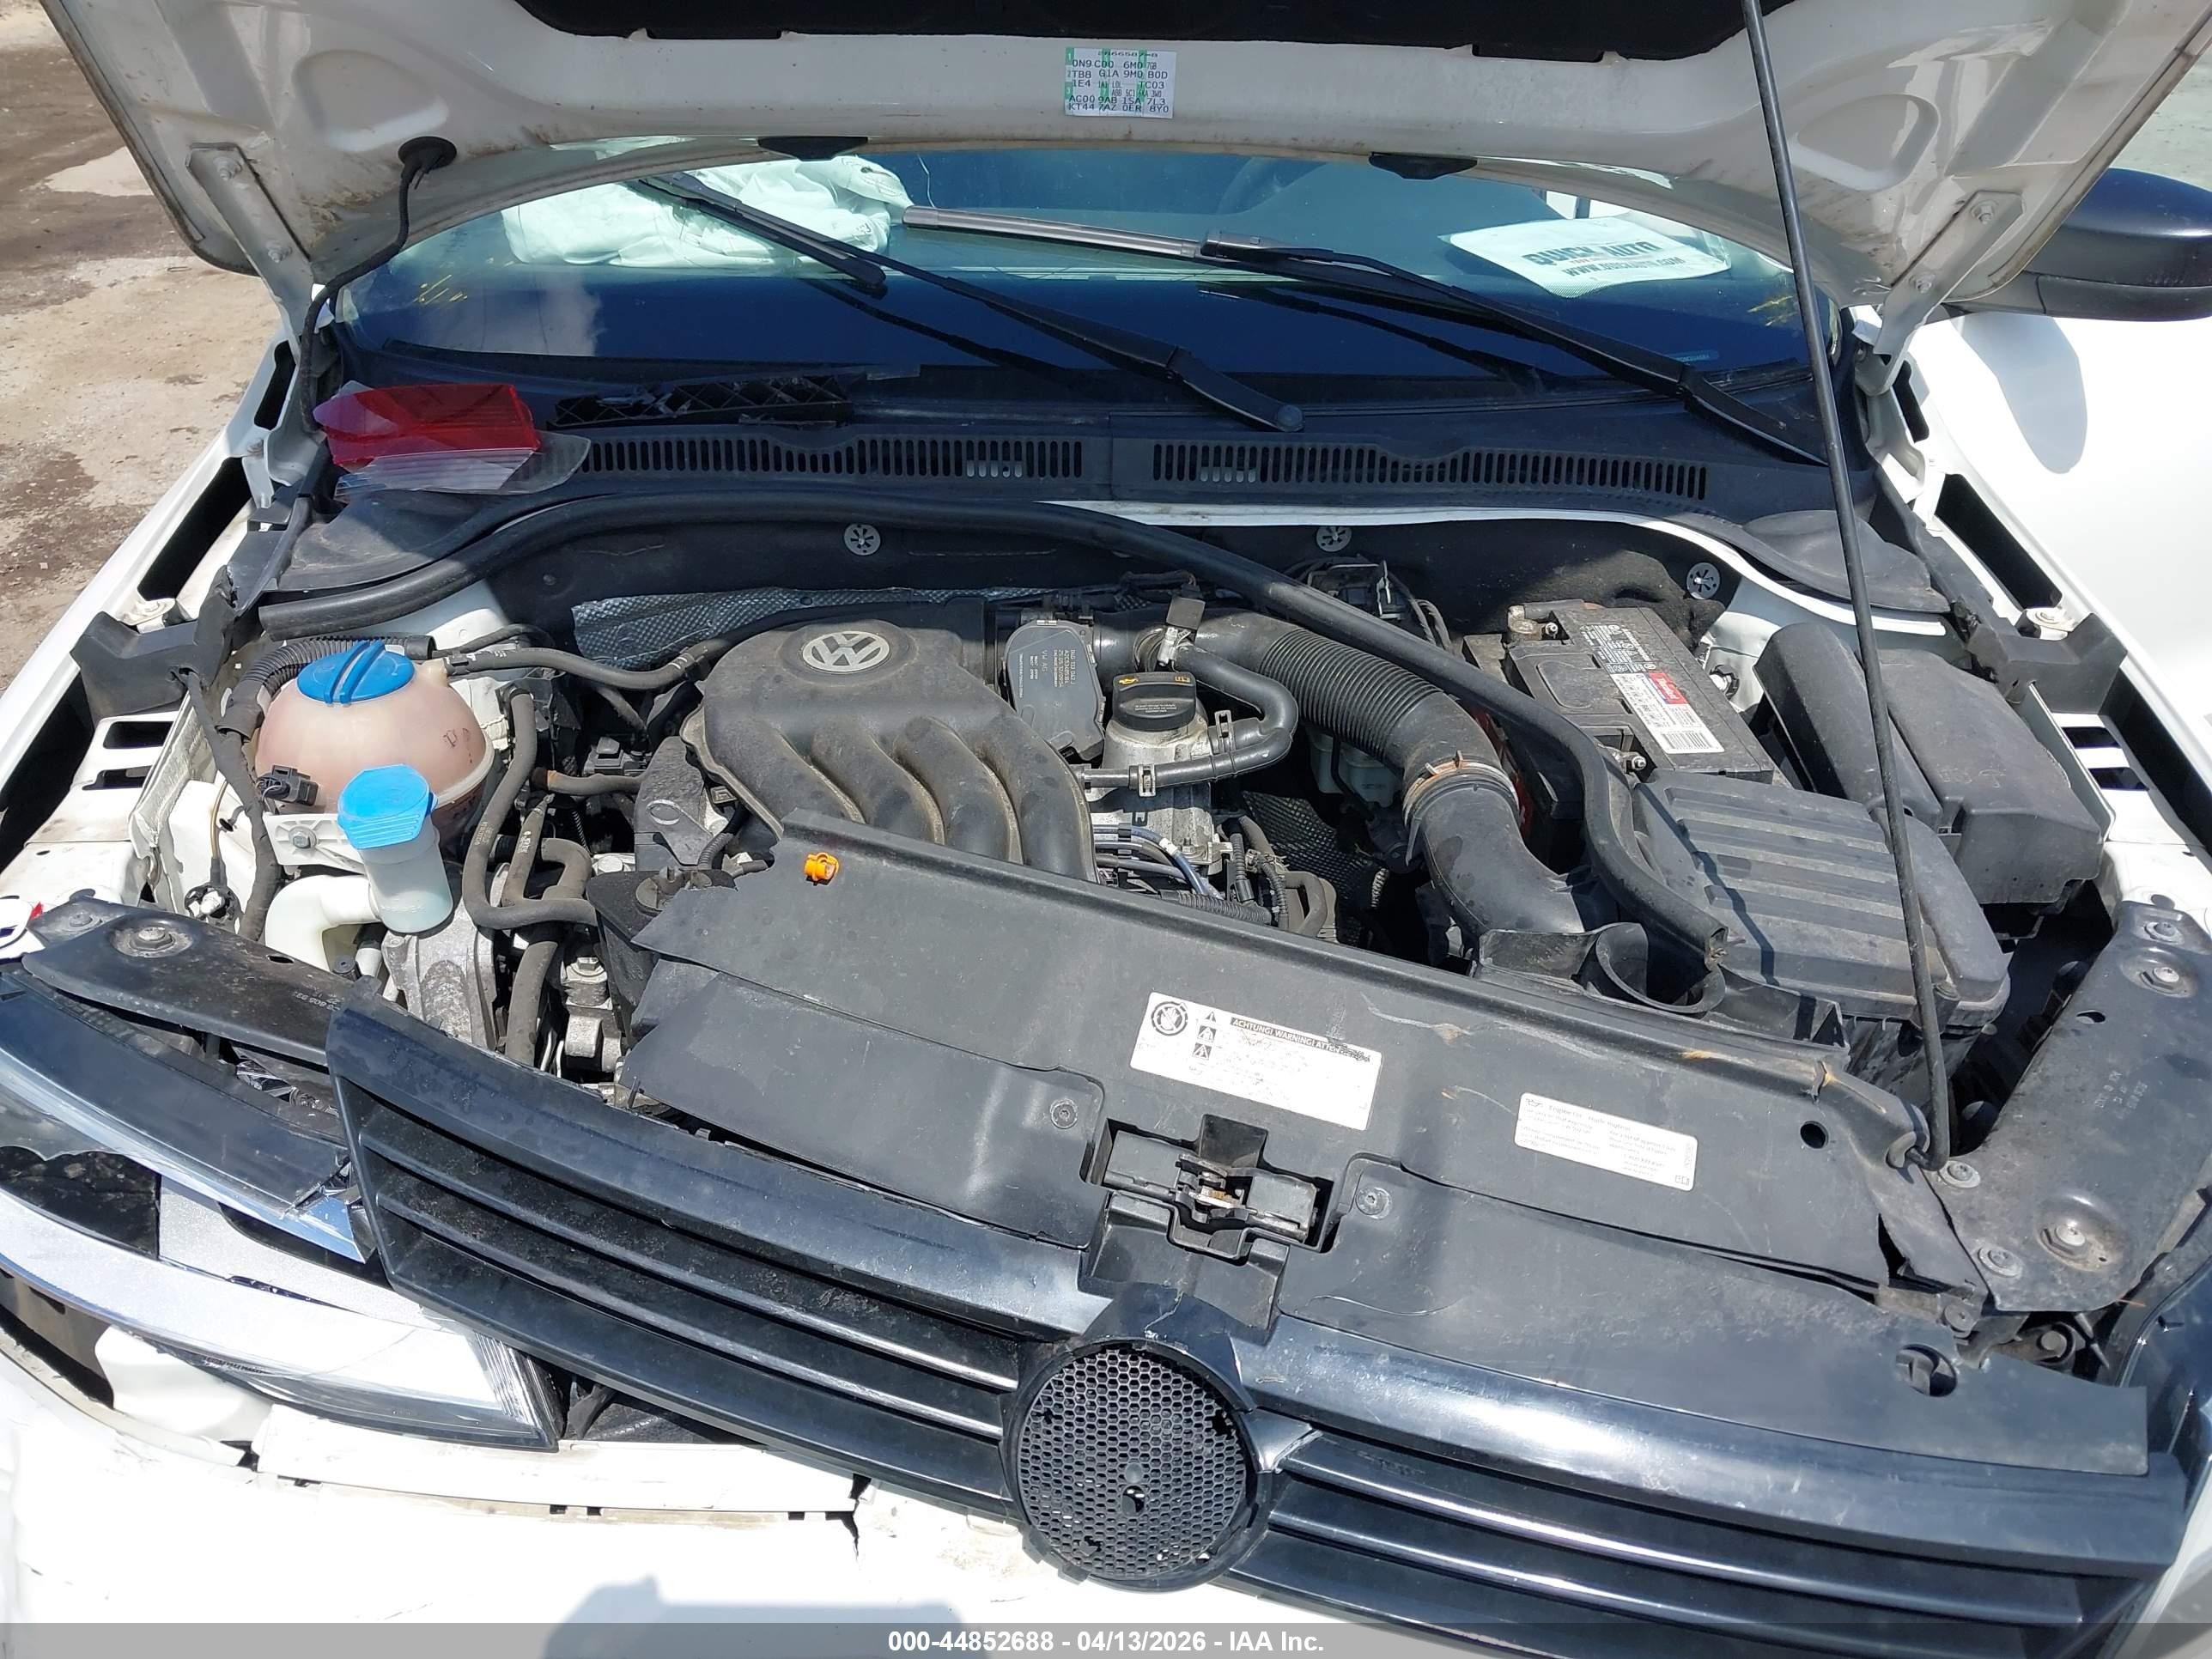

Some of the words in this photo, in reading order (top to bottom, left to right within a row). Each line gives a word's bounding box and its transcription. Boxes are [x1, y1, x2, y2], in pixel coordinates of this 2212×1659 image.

[1520, 246, 1597, 266] QUICK
[1598, 241, 1663, 257] AUTO
[1273, 1029, 1315, 1048] WARNING!
